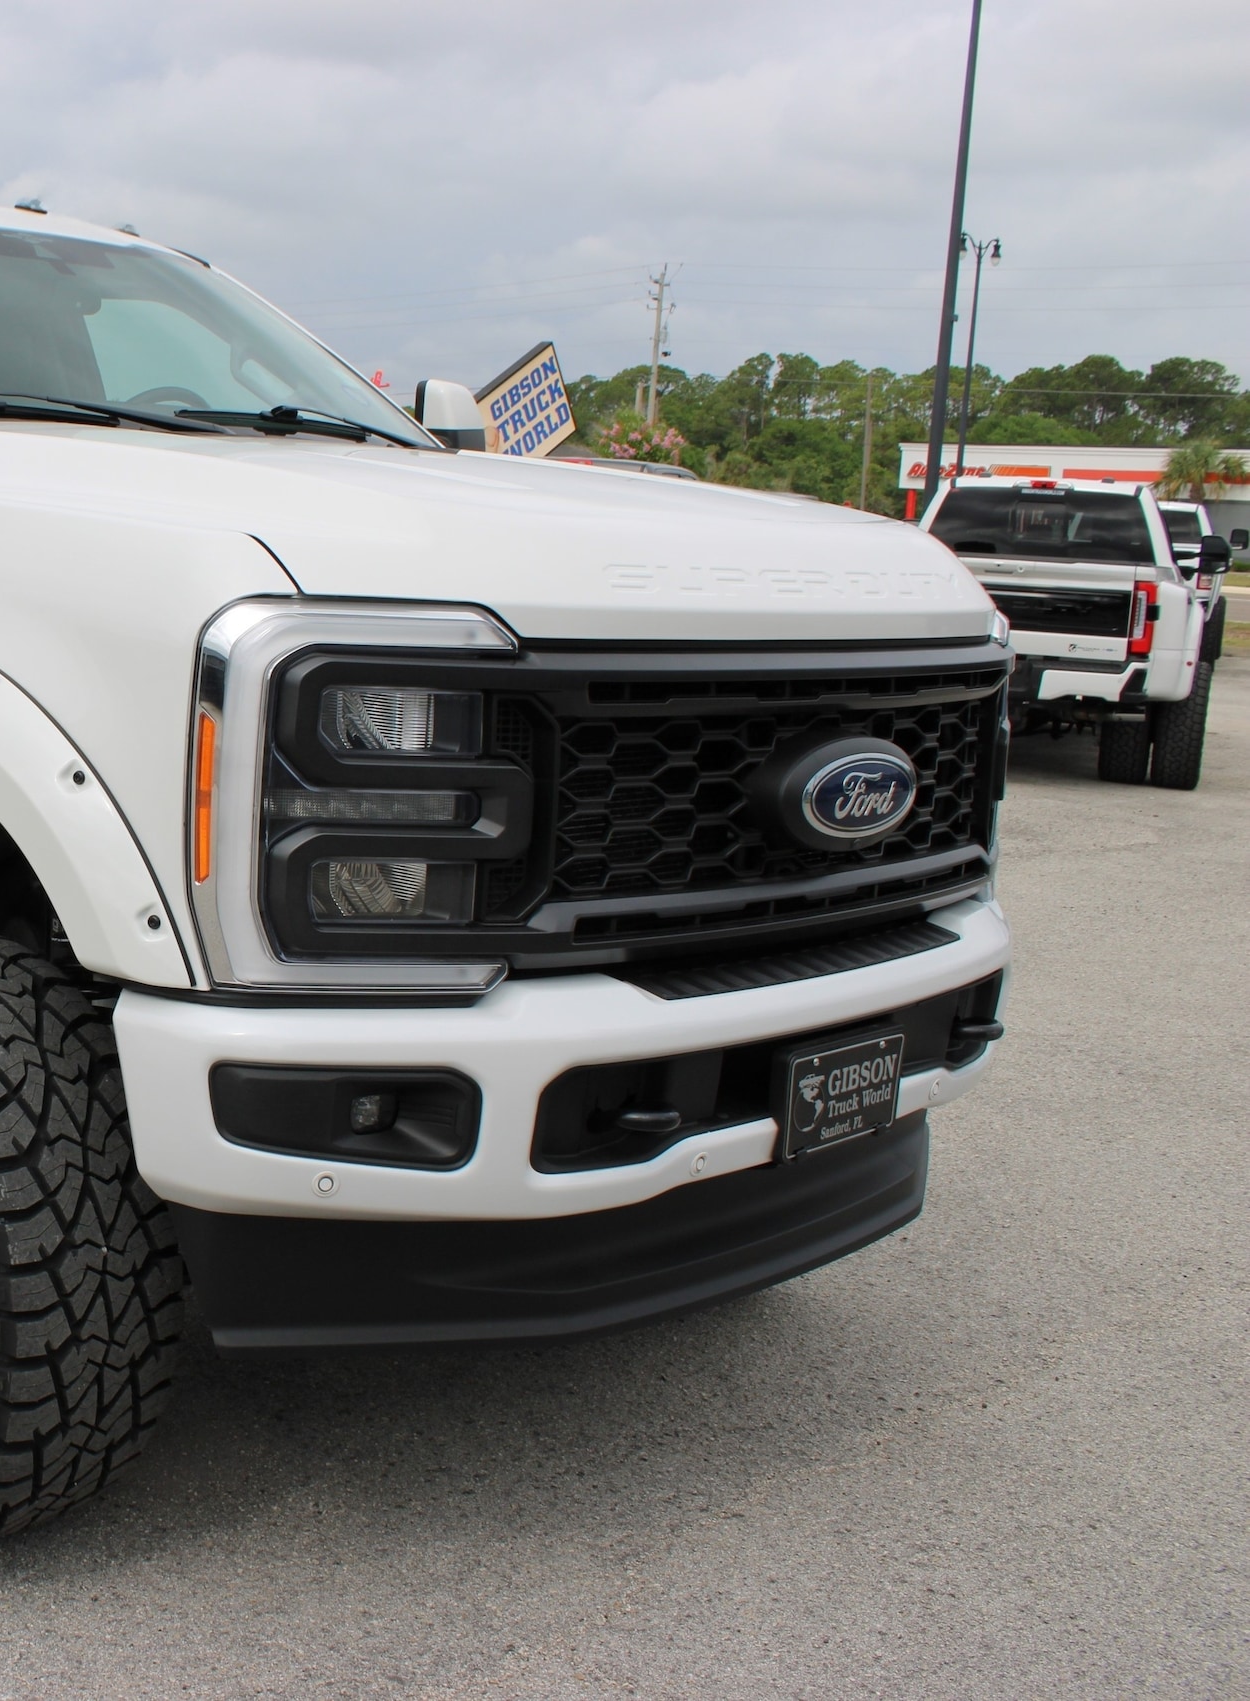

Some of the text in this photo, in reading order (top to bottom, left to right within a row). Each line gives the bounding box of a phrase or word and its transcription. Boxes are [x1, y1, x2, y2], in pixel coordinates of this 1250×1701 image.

[490, 355, 558, 421] GIBSON
[496, 378, 564, 443] TRUCK
[834, 771, 897, 820] Ford
[828, 1054, 898, 1096] GIBSON
[828, 1082, 892, 1118] Truck World
[820, 1115, 863, 1140] Sanford, FL
